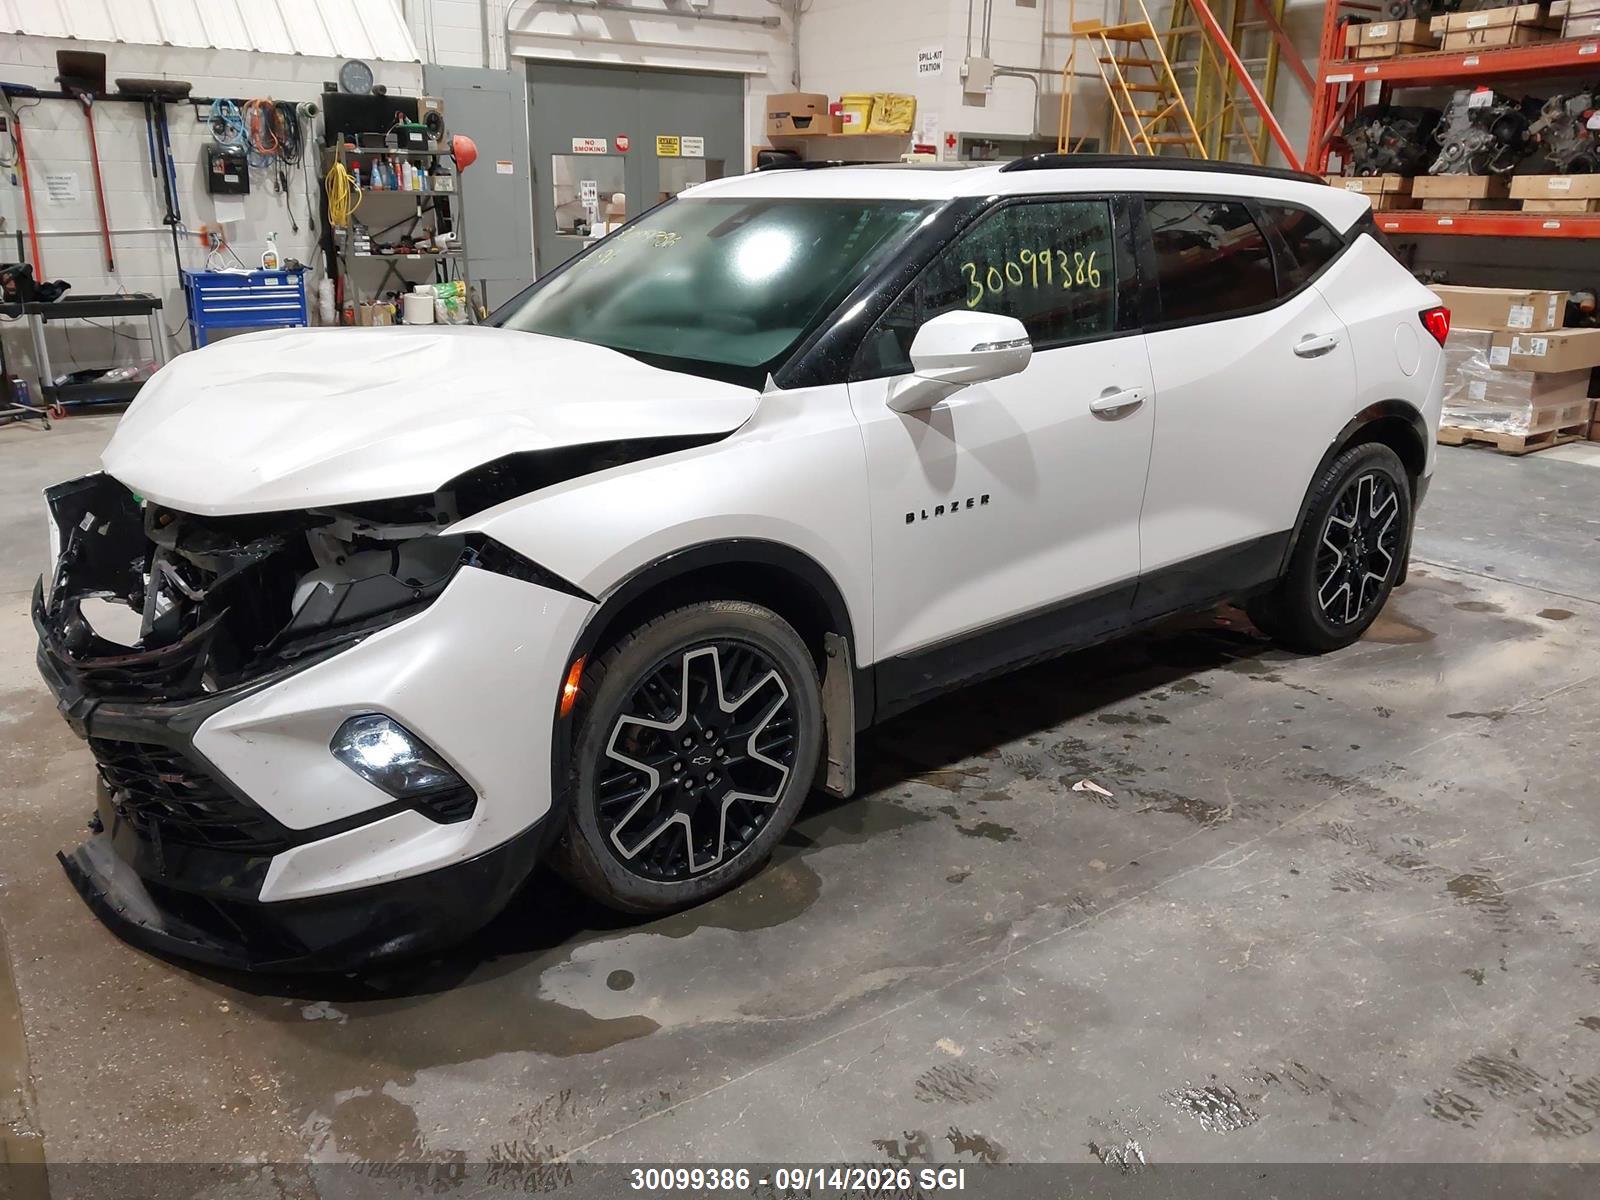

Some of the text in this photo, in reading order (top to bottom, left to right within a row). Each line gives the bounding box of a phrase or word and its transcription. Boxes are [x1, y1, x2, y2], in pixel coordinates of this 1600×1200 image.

[918, 50, 942, 62] SPILL-KIT
[919, 62, 941, 73] STATION
[960, 248, 1100, 308] 30099386
[905, 494, 990, 525] BLAZER
